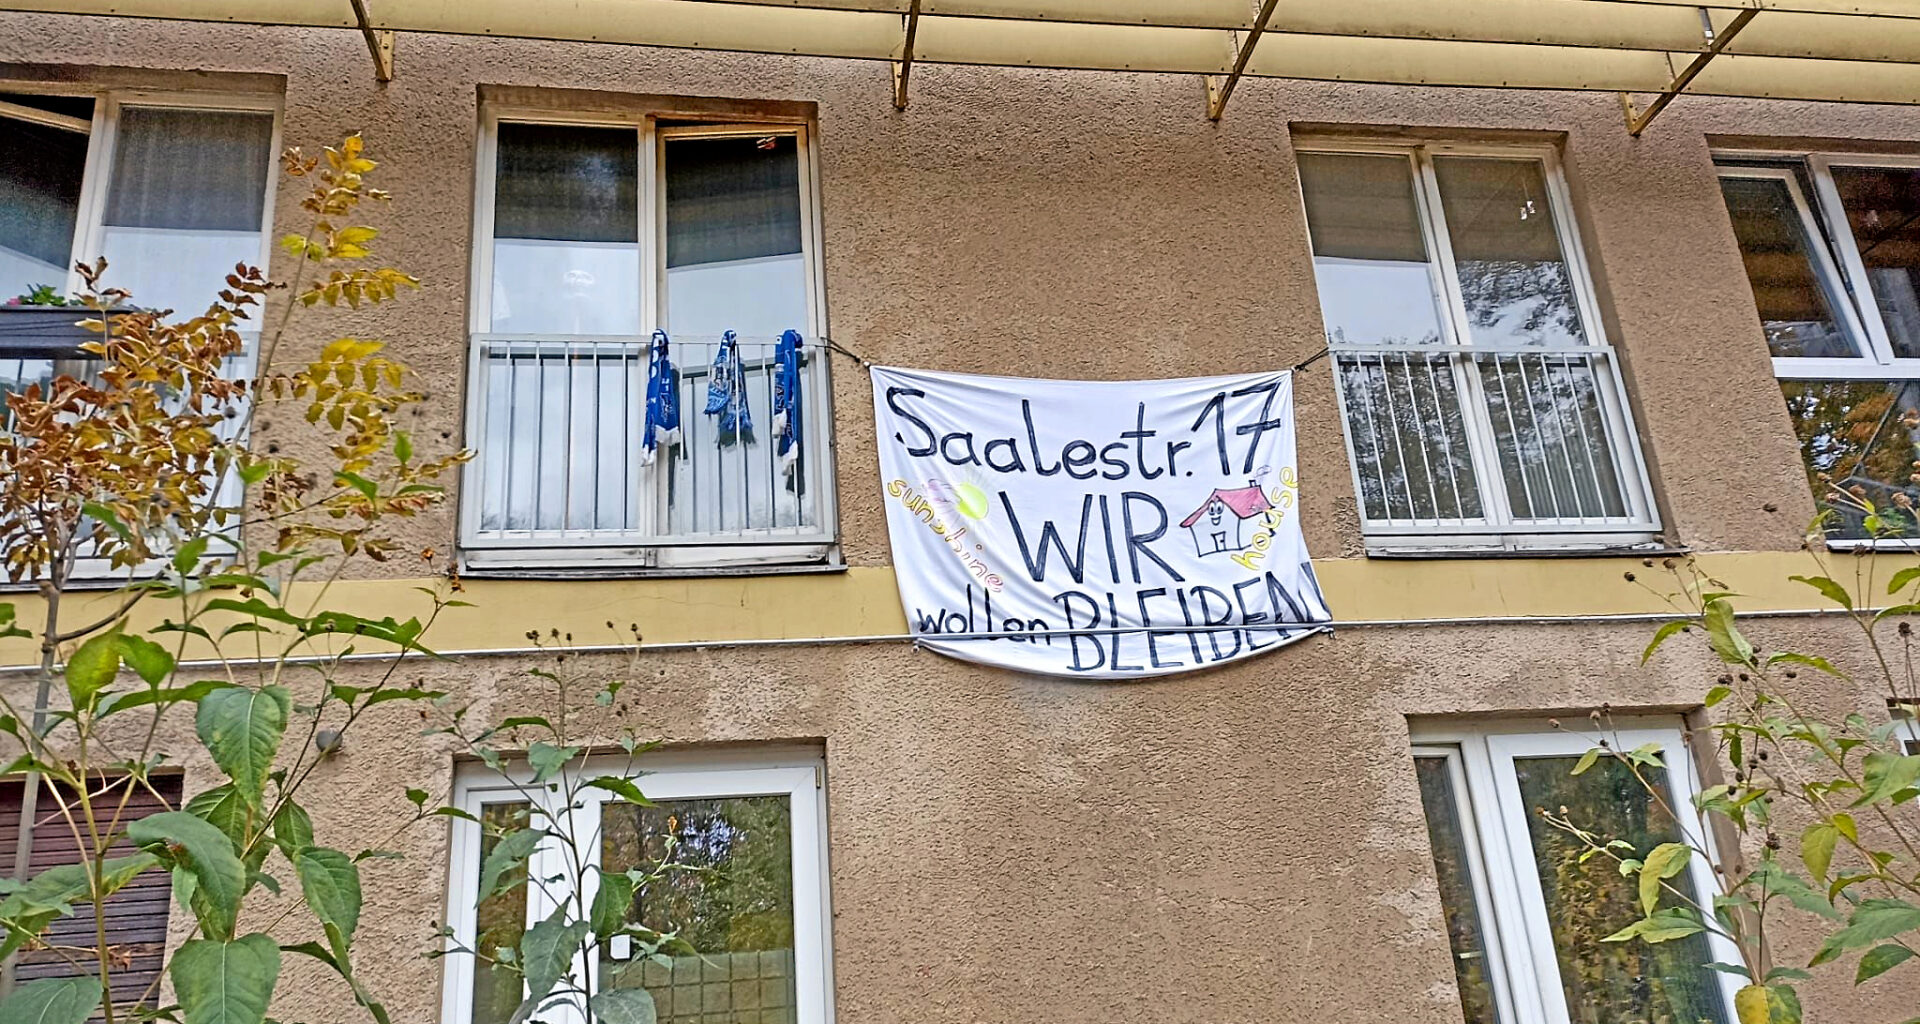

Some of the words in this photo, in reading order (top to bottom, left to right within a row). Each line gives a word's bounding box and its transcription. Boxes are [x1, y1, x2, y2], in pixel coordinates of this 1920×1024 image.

[885, 386, 1194, 480] Saalestr.
[1190, 381, 1282, 476] 17
[998, 490, 1186, 585] WIR
[1230, 466, 1299, 571] house
[915, 583, 1051, 646] wollen
